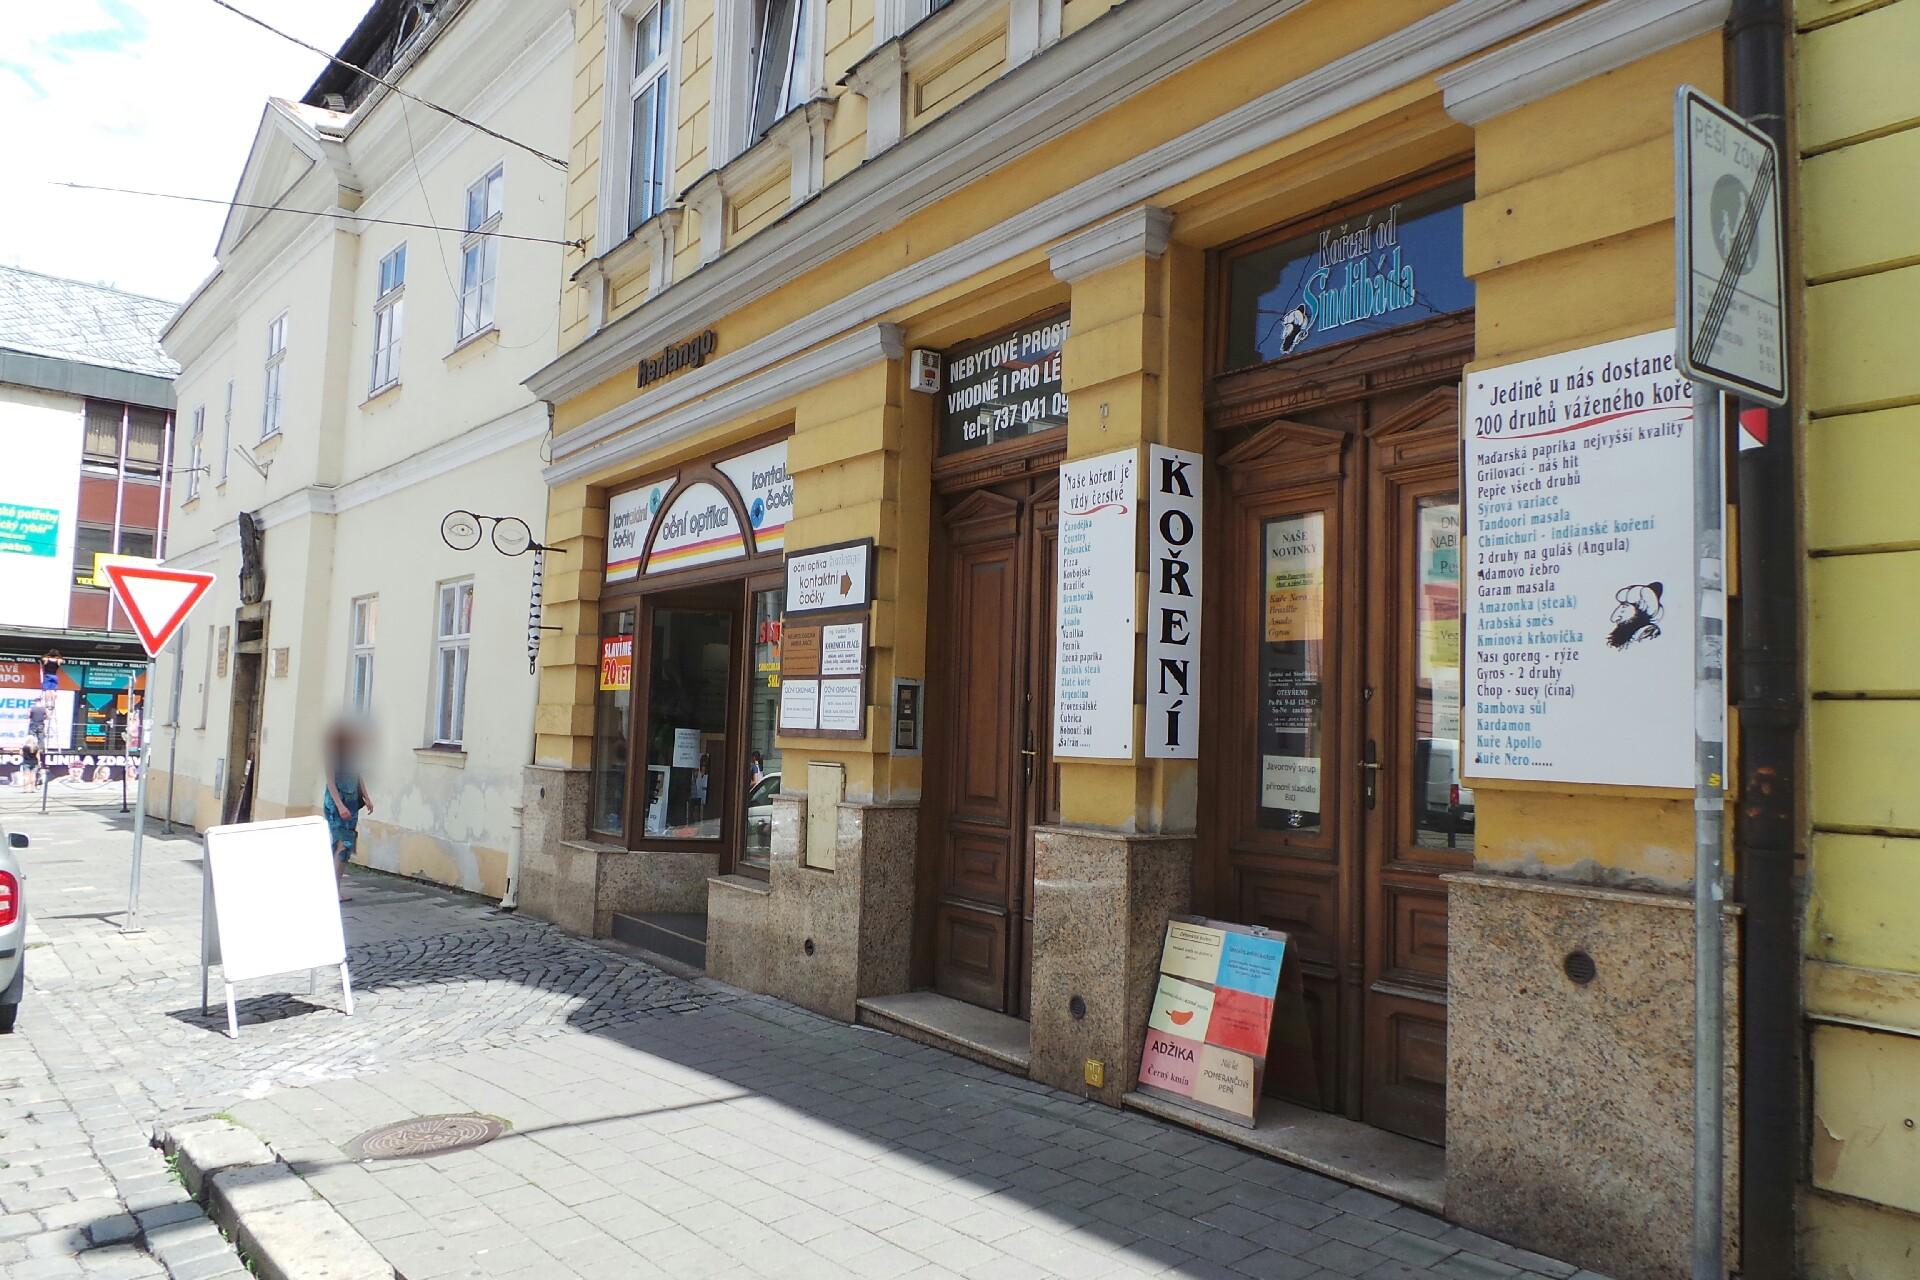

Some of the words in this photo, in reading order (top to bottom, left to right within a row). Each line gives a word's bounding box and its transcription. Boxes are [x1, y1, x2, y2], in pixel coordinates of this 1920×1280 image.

[1319, 215, 1373, 269] Koření
[1376, 204, 1403, 248] od
[1303, 246, 1415, 332] Sindibáda
[951, 333, 1018, 383] NEBYTOVÉ
[1022, 321, 1073, 356] PROST
[948, 371, 999, 414] VHODNÉ
[1003, 375, 1007, 395] I
[1011, 365, 1040, 393] PRO
[1490, 377, 1542, 406] Jedině
[1550, 378, 1558, 393] u
[1567, 366, 1593, 390] nás
[964, 416, 990, 440] tel.:
[994, 405, 1017, 431] 737
[1022, 396, 1045, 423] 041
[1475, 414, 1502, 436] 200
[1510, 400, 1555, 430] druhů
[1564, 388, 1643, 420] váženého
[1477, 447, 1527, 466] Maďarská
[1533, 440, 1575, 460] paprika
[1584, 432, 1632, 450] nejvyšší
[1638, 422, 1683, 440] kvality
[1066, 474, 1086, 490] Naše
[1090, 465, 1116, 486] koření
[1120, 464, 1129, 483] je
[1478, 463, 1525, 482] Grilovací
[1538, 458, 1558, 472] náš
[1563, 456, 1578, 469] hit
[1478, 485, 1506, 500] Pepře
[1512, 478, 1541, 493] všech
[1547, 471, 1580, 488] druhů
[1071, 494, 1088, 510] vždy
[1093, 484, 1123, 505] čerstvé
[1518, 495, 1558, 509] variace
[613, 502, 648, 529] kontaktní
[663, 511, 688, 540] oční
[690, 505, 728, 537] optika
[1479, 514, 1526, 531] Tandoori
[1531, 510, 1569, 525] masala
[613, 529, 635, 548] čočky
[1479, 530, 1536, 547] Chimichuri
[1551, 521, 1608, 539] indiánské
[1614, 515, 1655, 532] koření
[1272, 544, 1316, 559] NOVINKY
[1479, 553, 1484, 564] 2
[1488, 550, 1518, 564] druhy
[1524, 551, 1536, 559] na
[1542, 543, 1572, 560] guláš
[1578, 538, 1629, 555] (Angula)
[793, 562, 806, 573] oční
[808, 561, 827, 572] optika
[1064, 559, 1078, 567] Pizza
[1478, 568, 1524, 580] Adamovo
[1530, 563, 1560, 575] žebro
[800, 571, 838, 589] kontaktní
[1479, 585, 1511, 597] Garam
[1517, 580, 1555, 594] masala
[799, 590, 824, 605] čočky
[1159, 457, 1194, 746] KOŘENÍ
[1479, 599, 1533, 613] Amazonka
[1538, 595, 1577, 611] (steak)
[1478, 615, 1520, 629] Arabská
[1527, 615, 1554, 627] směs
[1063, 630, 1084, 638] Vanilka
[1478, 631, 1521, 646] Kmínová
[1528, 630, 1582, 643] krkovička
[1080, 652, 1102, 663] paprika
[1503, 651, 1540, 665] goreng
[1554, 648, 1579, 663] rýže
[604, 659, 616, 684] 20
[1477, 668, 1504, 680] Gyros
[1519, 667, 1523, 678] 2
[1530, 666, 1562, 682] druhy
[1061, 690, 1088, 700] Argentina
[1477, 682, 1502, 699] Chop
[1515, 686, 1538, 699] suey
[1544, 683, 1574, 698] (čína)
[1477, 718, 1530, 730] Kardamon
[1477, 735, 1500, 748] Kuře
[1506, 736, 1541, 750] Apollo
[1151, 1040, 1194, 1063] ADŽIKA
[1148, 1064, 1169, 1079] Černý
[1171, 1073, 1189, 1085] kmín
